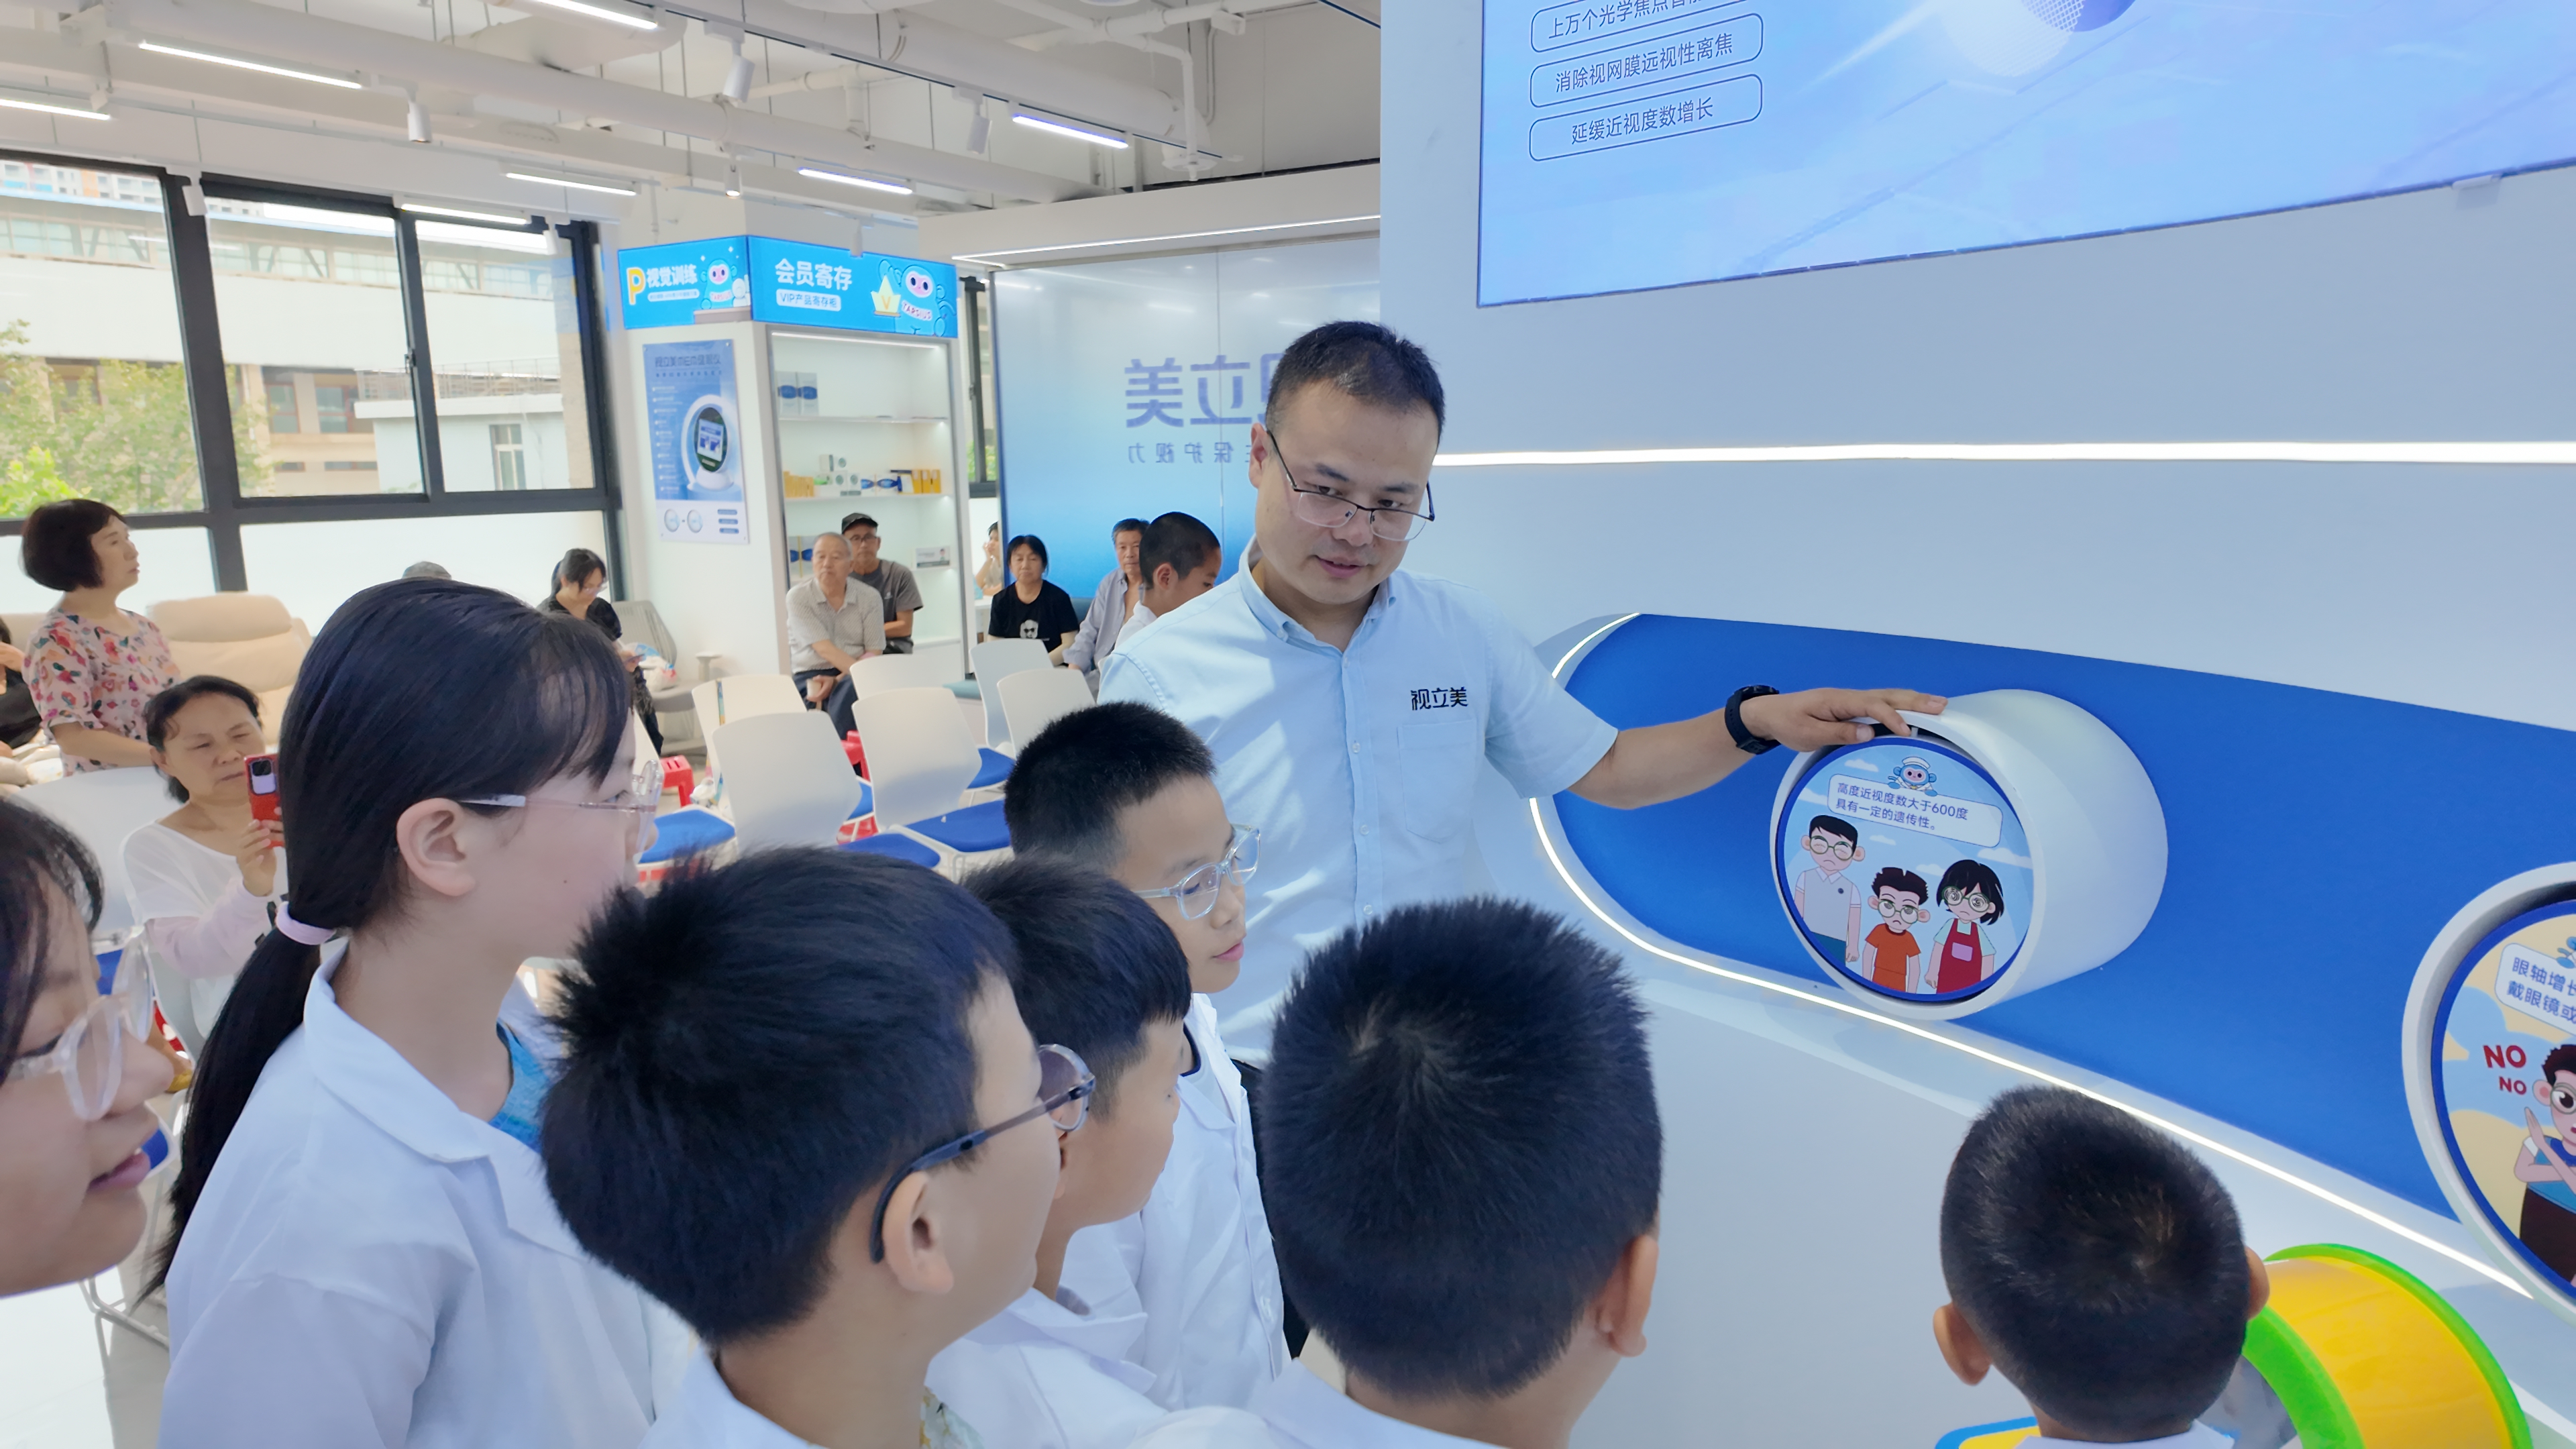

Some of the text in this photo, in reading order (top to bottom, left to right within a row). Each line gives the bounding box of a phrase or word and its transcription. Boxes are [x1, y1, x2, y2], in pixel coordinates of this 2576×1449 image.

[1548, 0, 1701, 39] 上万个光学焦点
[1556, 33, 1733, 93] 消除视网膜远视性离焦
[1572, 97, 1713, 144] 延缓近视度数增长
[647, 264, 698, 288] 视觉训练
[775, 258, 853, 290] 会员寄存
[780, 292, 837, 309] VIP产品寄存柜
[1411, 686, 1468, 710] 视立美
[1835, 798, 1935, 830] 具有一定的遗传性。
[1837, 782, 1969, 820] 高度近视度数大于600度
[2507, 980, 2576, 1024] 戴眼镜或
[2483, 1044, 2526, 1069] NO
[2499, 1075, 2527, 1095] NO
